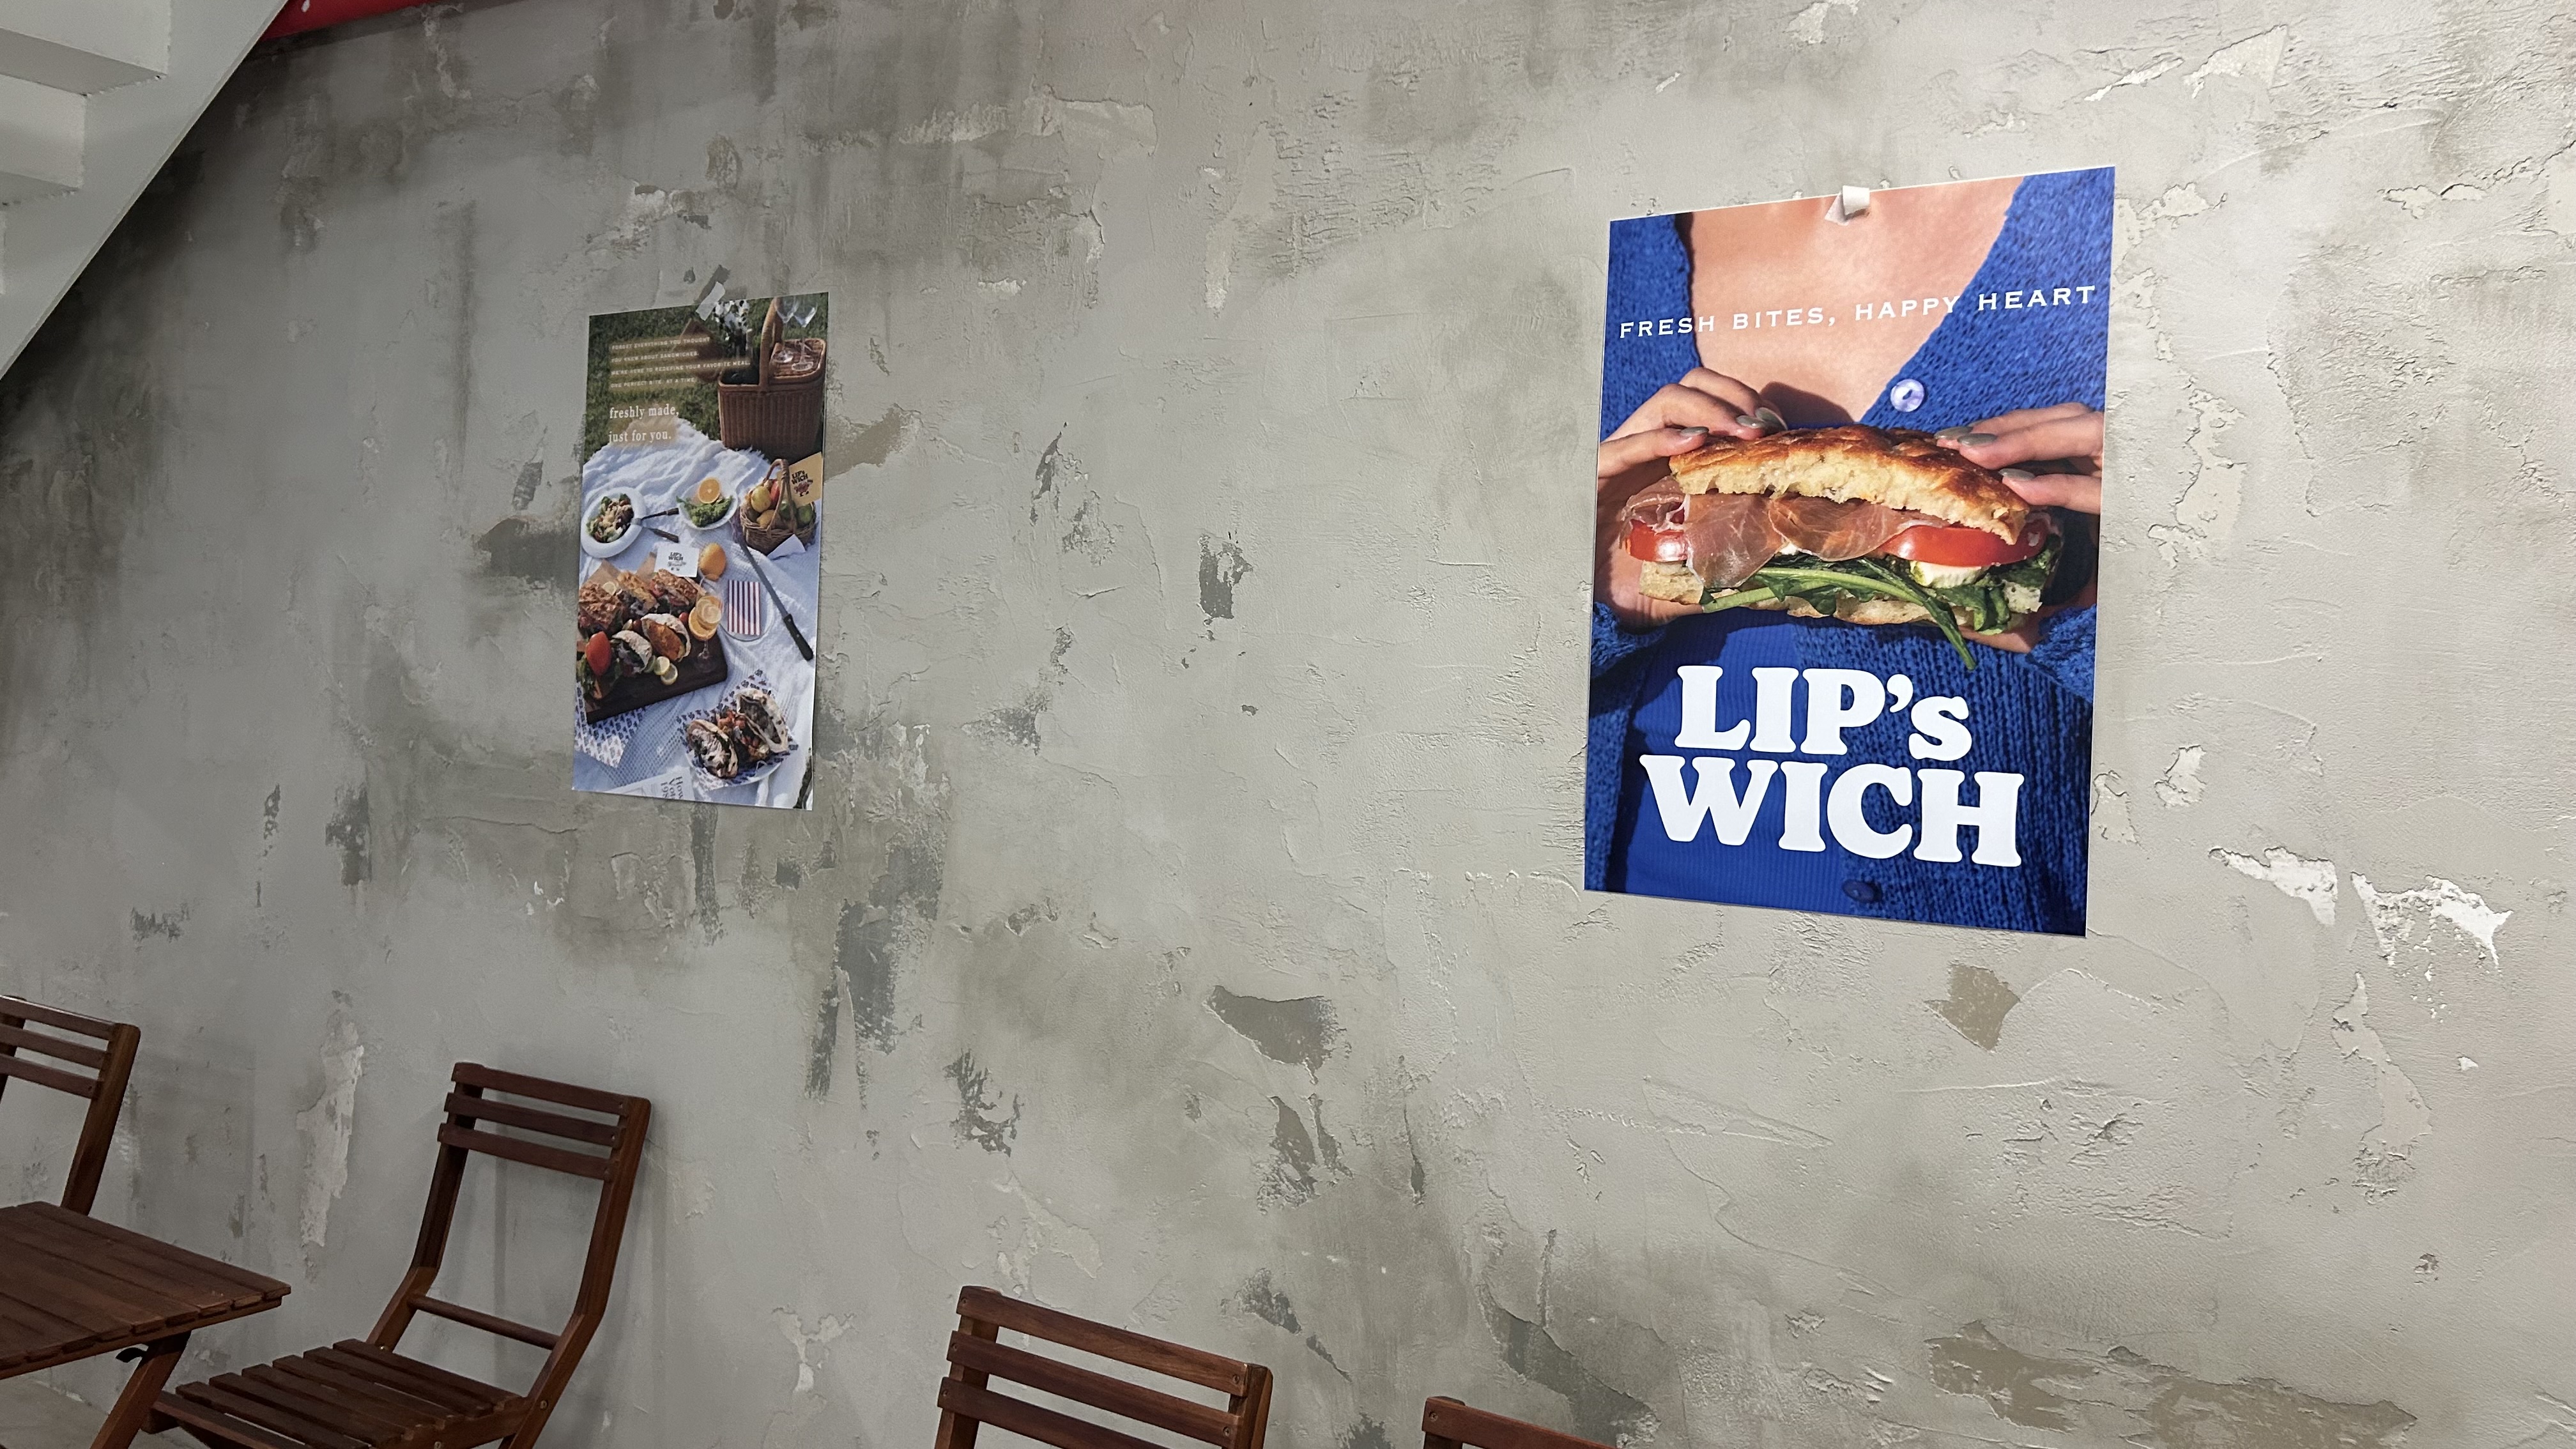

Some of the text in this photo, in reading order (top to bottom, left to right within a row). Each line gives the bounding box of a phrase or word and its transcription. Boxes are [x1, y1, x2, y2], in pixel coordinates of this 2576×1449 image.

[1620, 285, 2096, 339] FRESH BITES, HAPPY HEART
[610, 404, 679, 420] freshly made,
[609, 429, 671, 444] just for you.
[791, 473, 809, 484] WICH
[1675, 665, 1973, 762] LIP's
[1639, 754, 2024, 867] WICH
